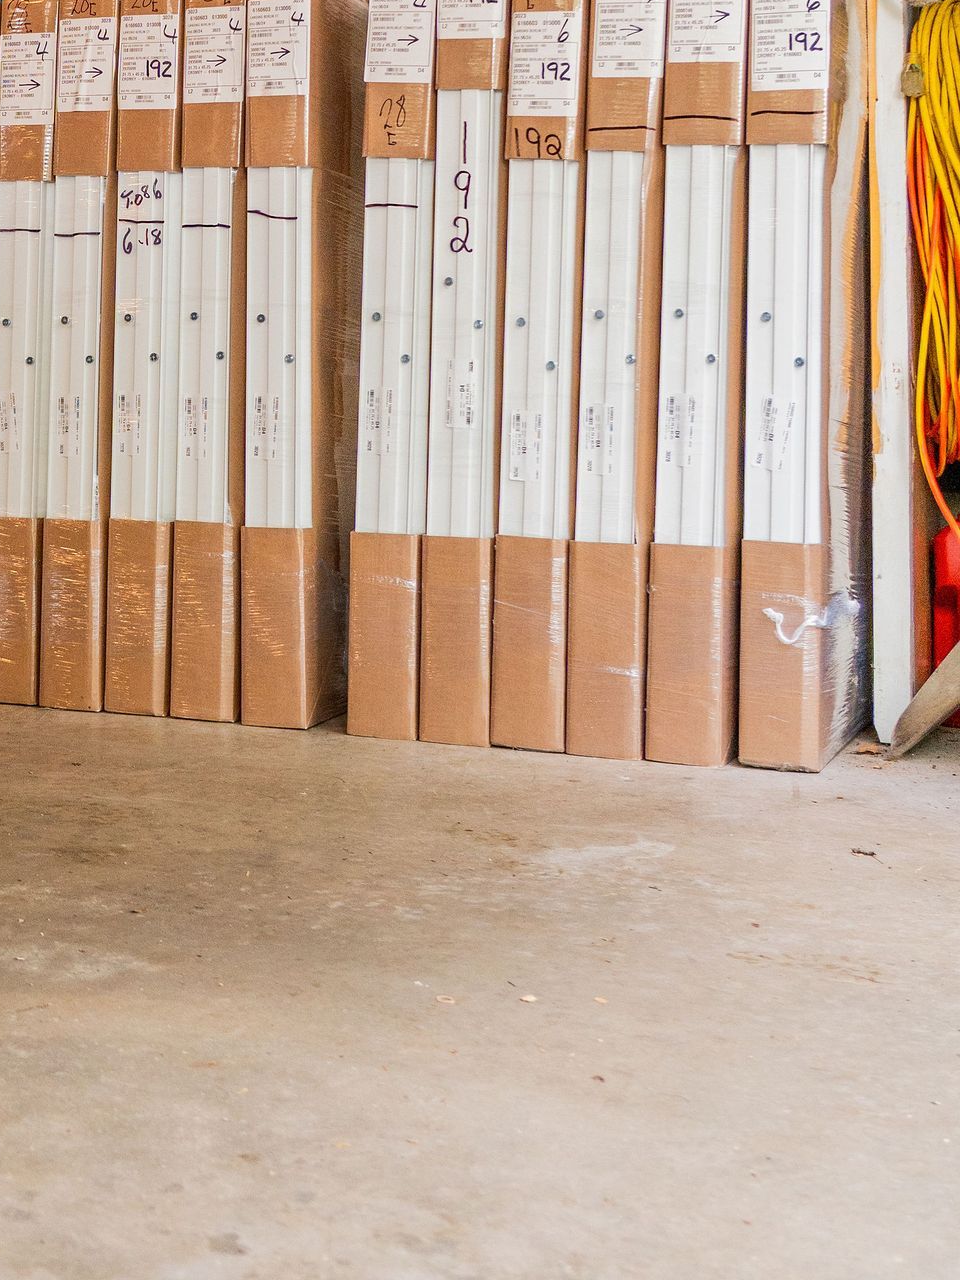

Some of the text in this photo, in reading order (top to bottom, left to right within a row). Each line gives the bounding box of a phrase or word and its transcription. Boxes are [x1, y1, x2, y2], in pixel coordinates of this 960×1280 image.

[229, 18, 242, 34] 4
[291, 11, 304, 26] 4
[97, 28, 109, 41] 4
[163, 24, 177, 45] 4
[557, 18, 569, 43] 6
[35, 41, 48, 61] 4
[789, 32, 823, 52] 192
[146, 60, 172, 78] 192
[541, 62, 571, 81] 192
[379, 94, 406, 130] 28
[514, 127, 563, 160] 192
